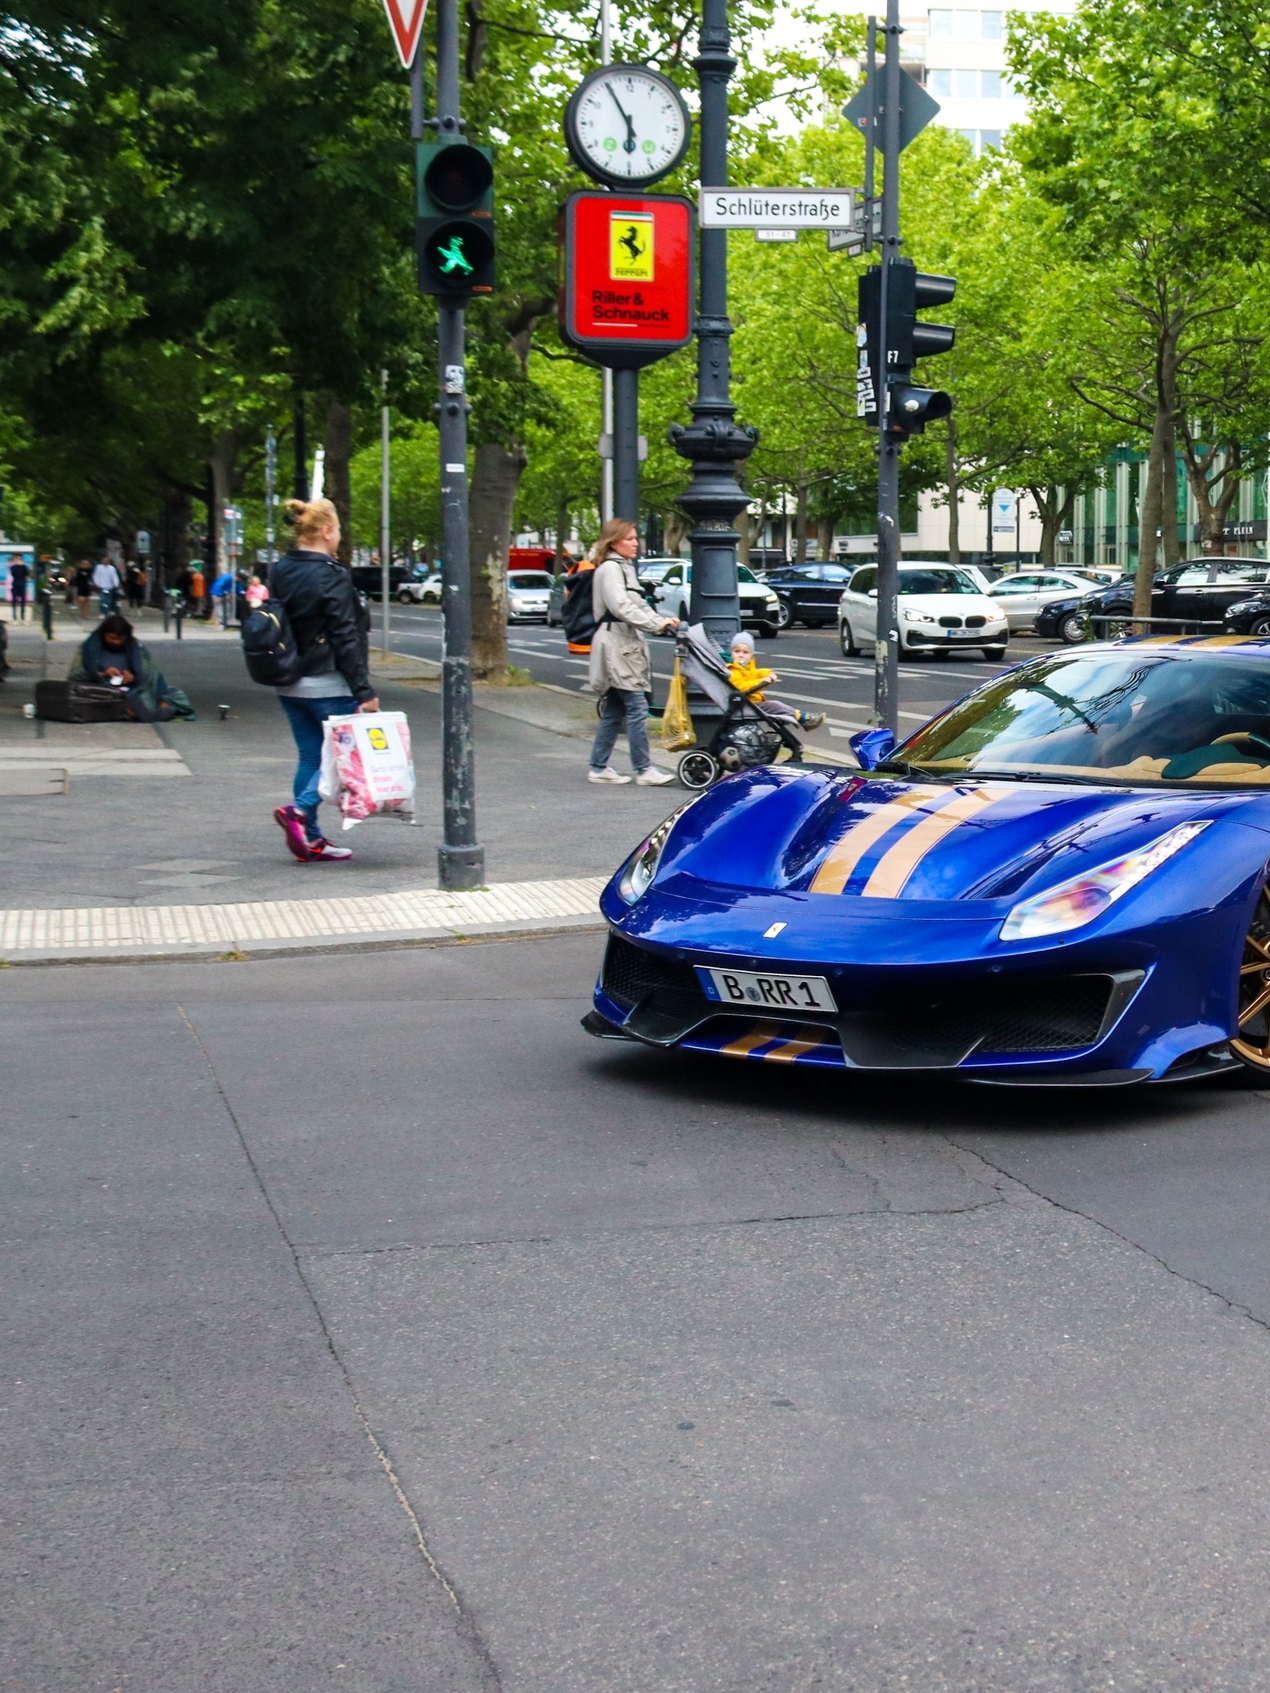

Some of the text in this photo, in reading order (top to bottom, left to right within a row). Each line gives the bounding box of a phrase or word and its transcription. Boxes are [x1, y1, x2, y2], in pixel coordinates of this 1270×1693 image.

[715, 197, 840, 221] Schlüterstraße
[592, 290, 643, 305] Riller &
[592, 305, 670, 321] Schnauck
[887, 350, 899, 363] F7
[722, 974, 745, 1000] B
